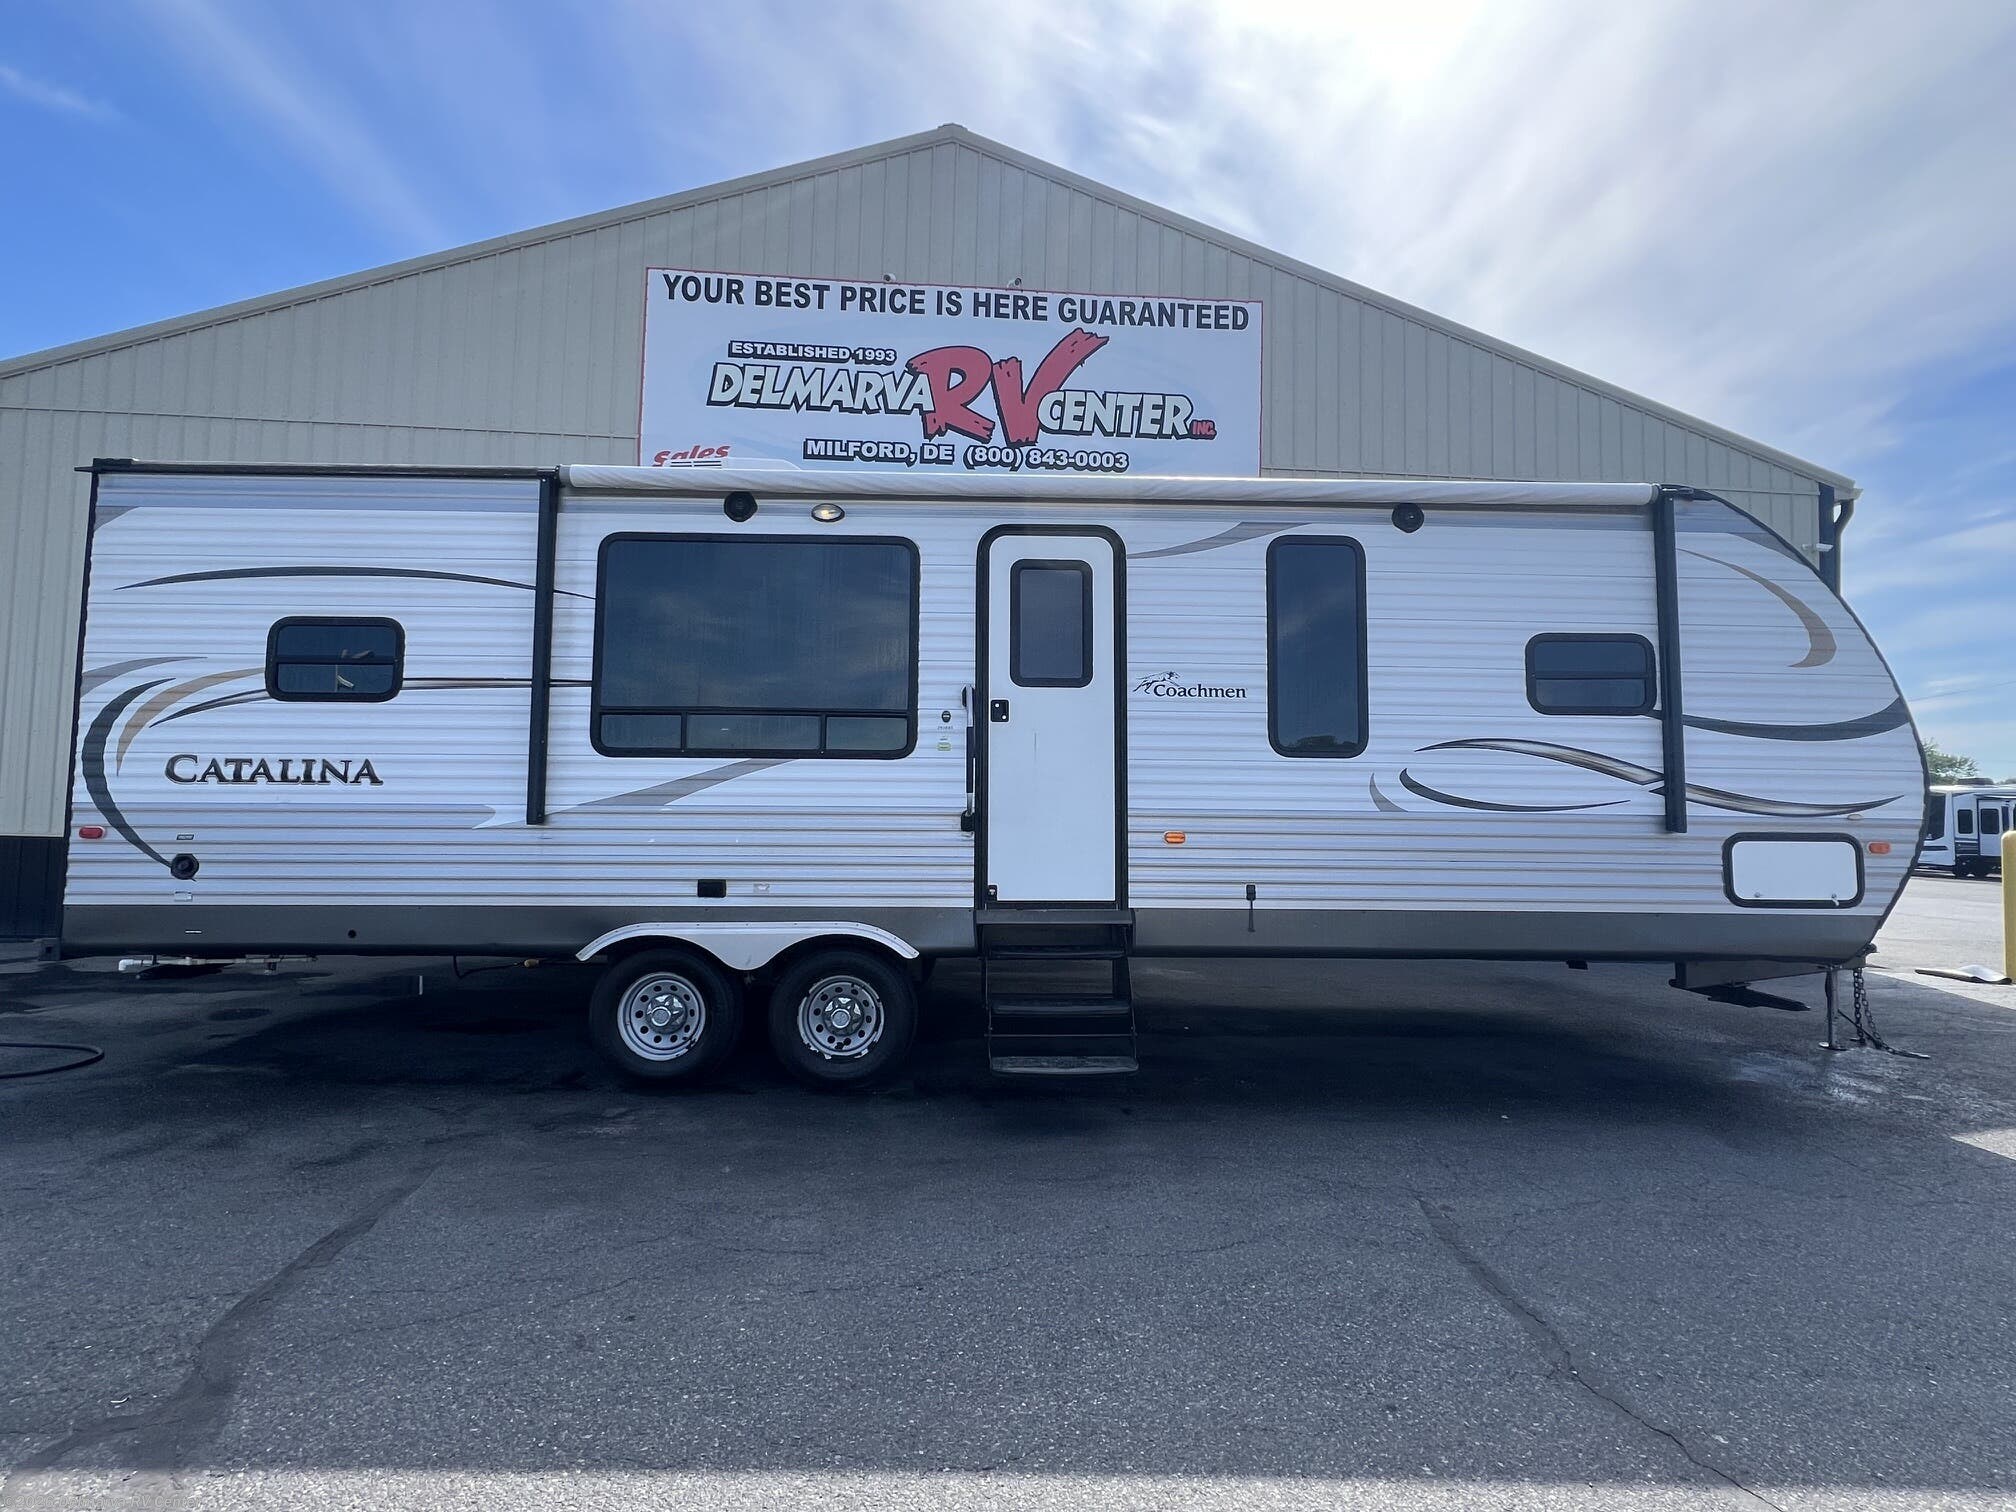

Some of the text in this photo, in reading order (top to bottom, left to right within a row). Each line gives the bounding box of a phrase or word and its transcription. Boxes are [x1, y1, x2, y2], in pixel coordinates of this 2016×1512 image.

[663, 274, 1250, 331] YOUR BEST PRICE IS HERE GUARANTEED
[730, 341, 897, 362] ESTABLISHED 1993
[709, 363, 936, 413] DELMARVA
[905, 327, 1110, 448] RV
[1037, 389, 1194, 440] CENTER
[806, 439, 1130, 469] MILFORD, DE (800) 843-0003
[1153, 683, 1247, 699] Coachmen
[165, 754, 384, 786] CATALINA
